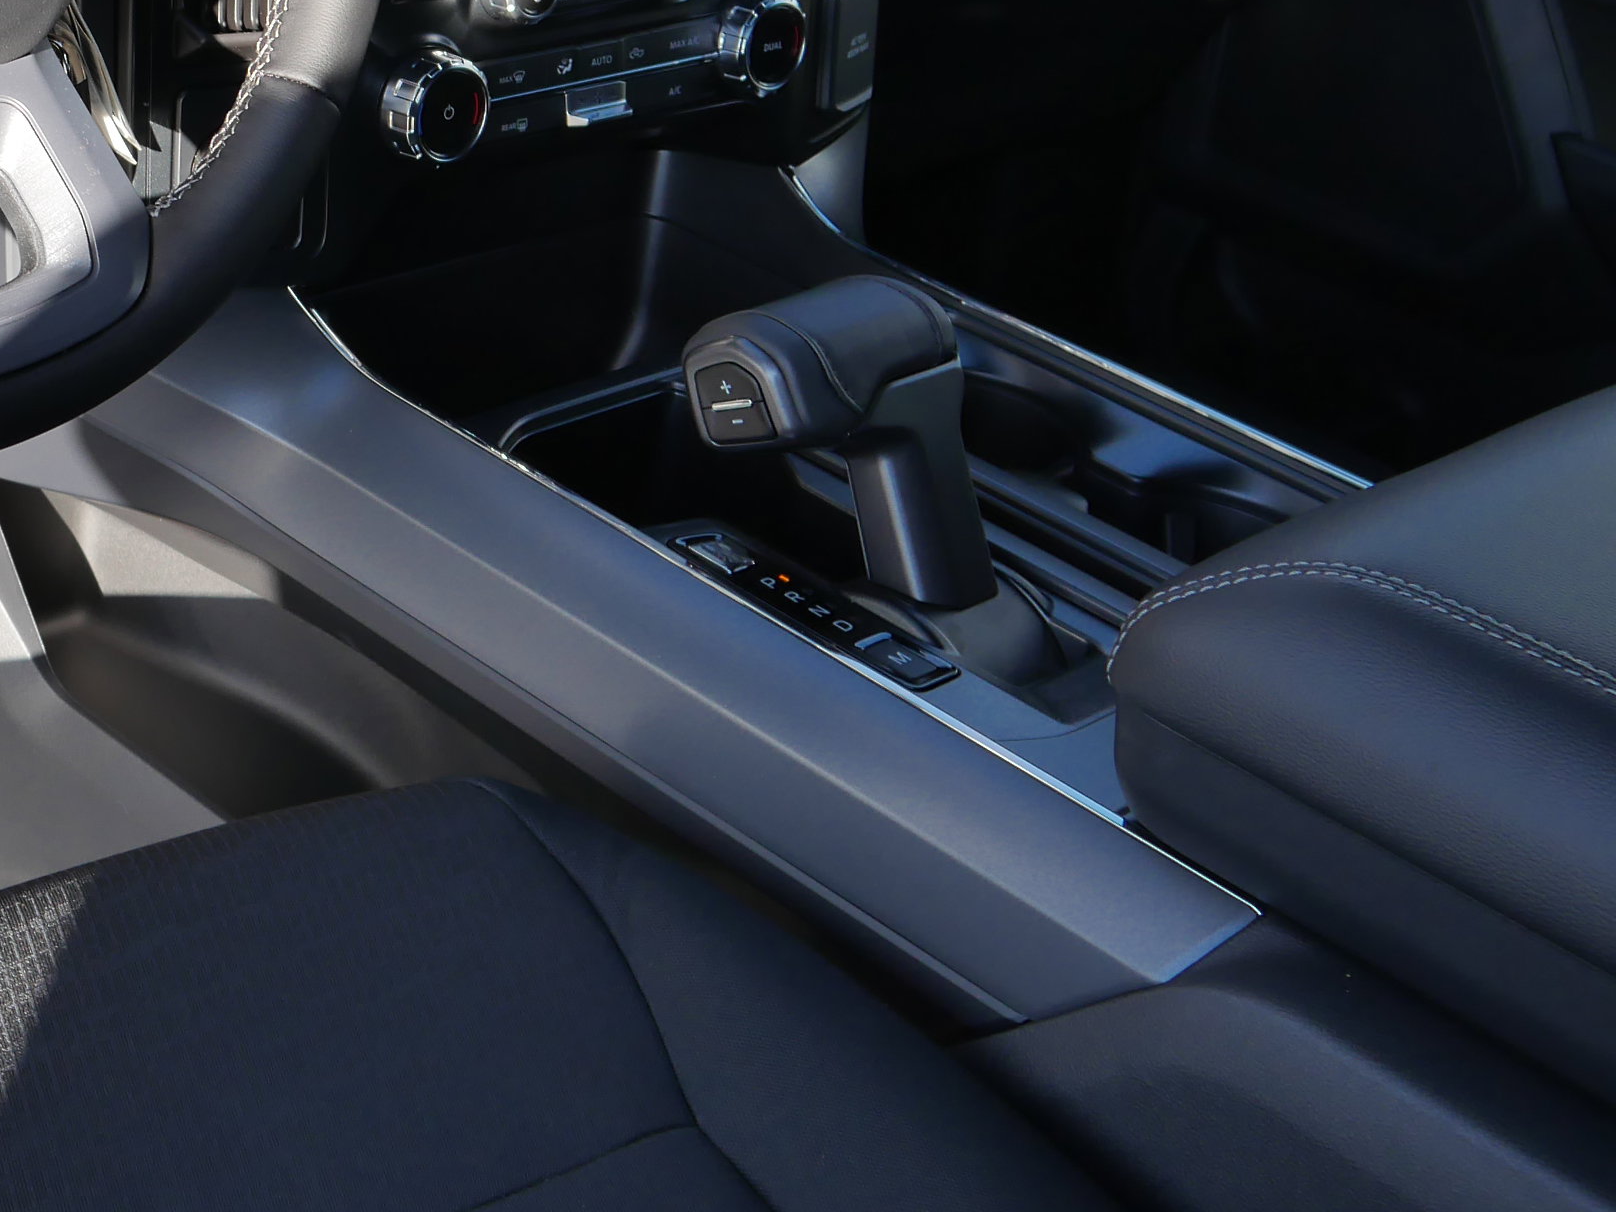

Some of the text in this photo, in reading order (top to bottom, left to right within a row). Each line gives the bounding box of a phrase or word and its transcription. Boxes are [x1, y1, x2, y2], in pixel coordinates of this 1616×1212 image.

[763, 41, 783, 52] DUAL
[591, 55, 613, 66] AUTO
[760, 577, 778, 590] P
[784, 590, 805, 604] R
[833, 619, 853, 633] D
[888, 651, 914, 666] M
